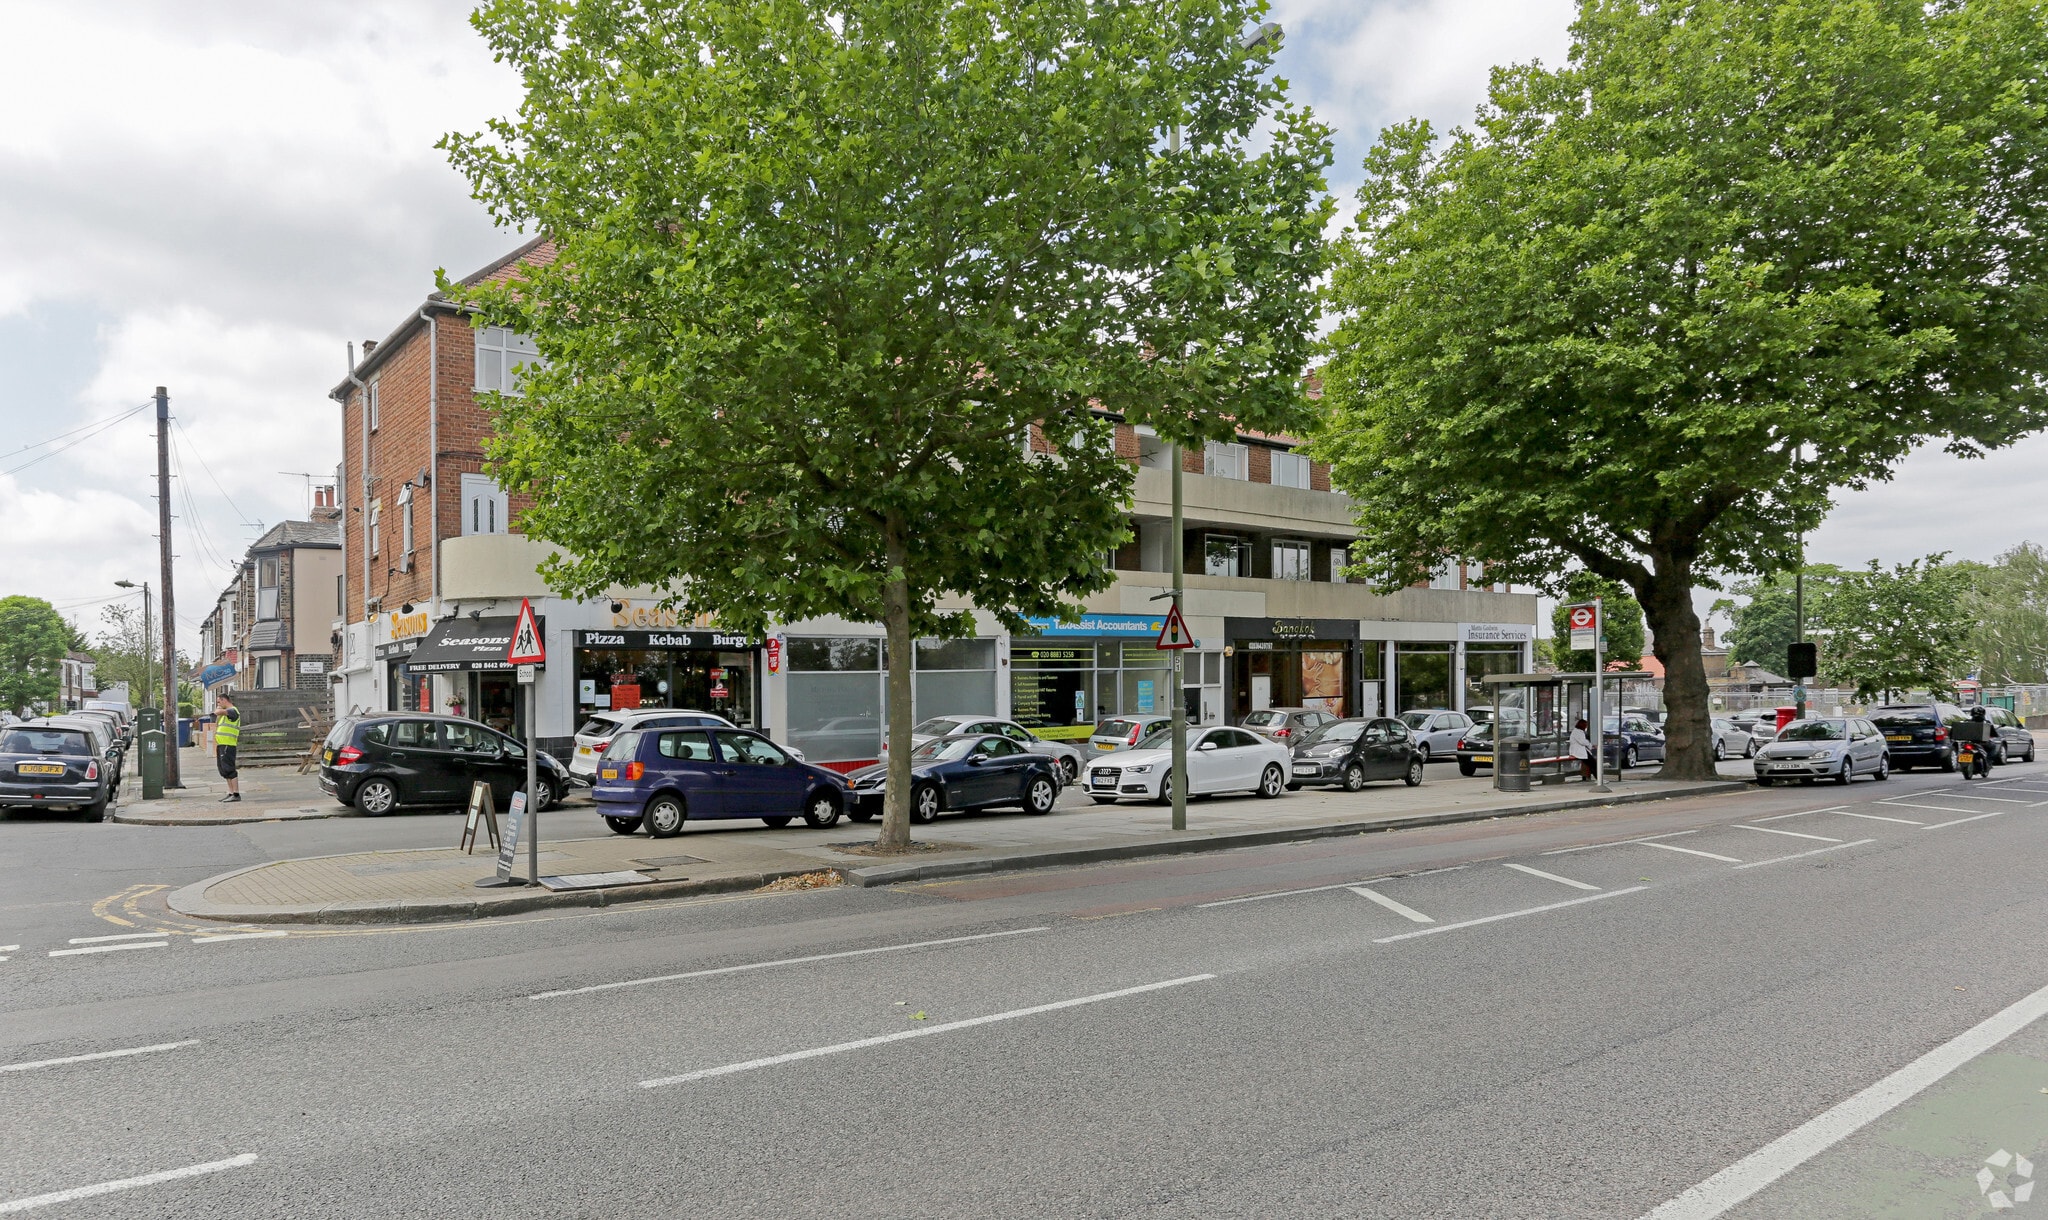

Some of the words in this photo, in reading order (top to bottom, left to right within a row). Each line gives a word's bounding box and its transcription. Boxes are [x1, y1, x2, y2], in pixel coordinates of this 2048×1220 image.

[391, 612, 428, 640] Seasons
[1097, 619, 1148, 631] Accountants
[1272, 620, 1315, 634] Bangkok
[585, 633, 625, 645] Pizza
[648, 634, 692, 646] Kebab
[1468, 629, 1500, 640] Insurance
[1501, 629, 1527, 640] Services
[438, 636, 511, 647] Seasons
[519, 669, 533, 678] School
[148, 741, 157, 749] 18
